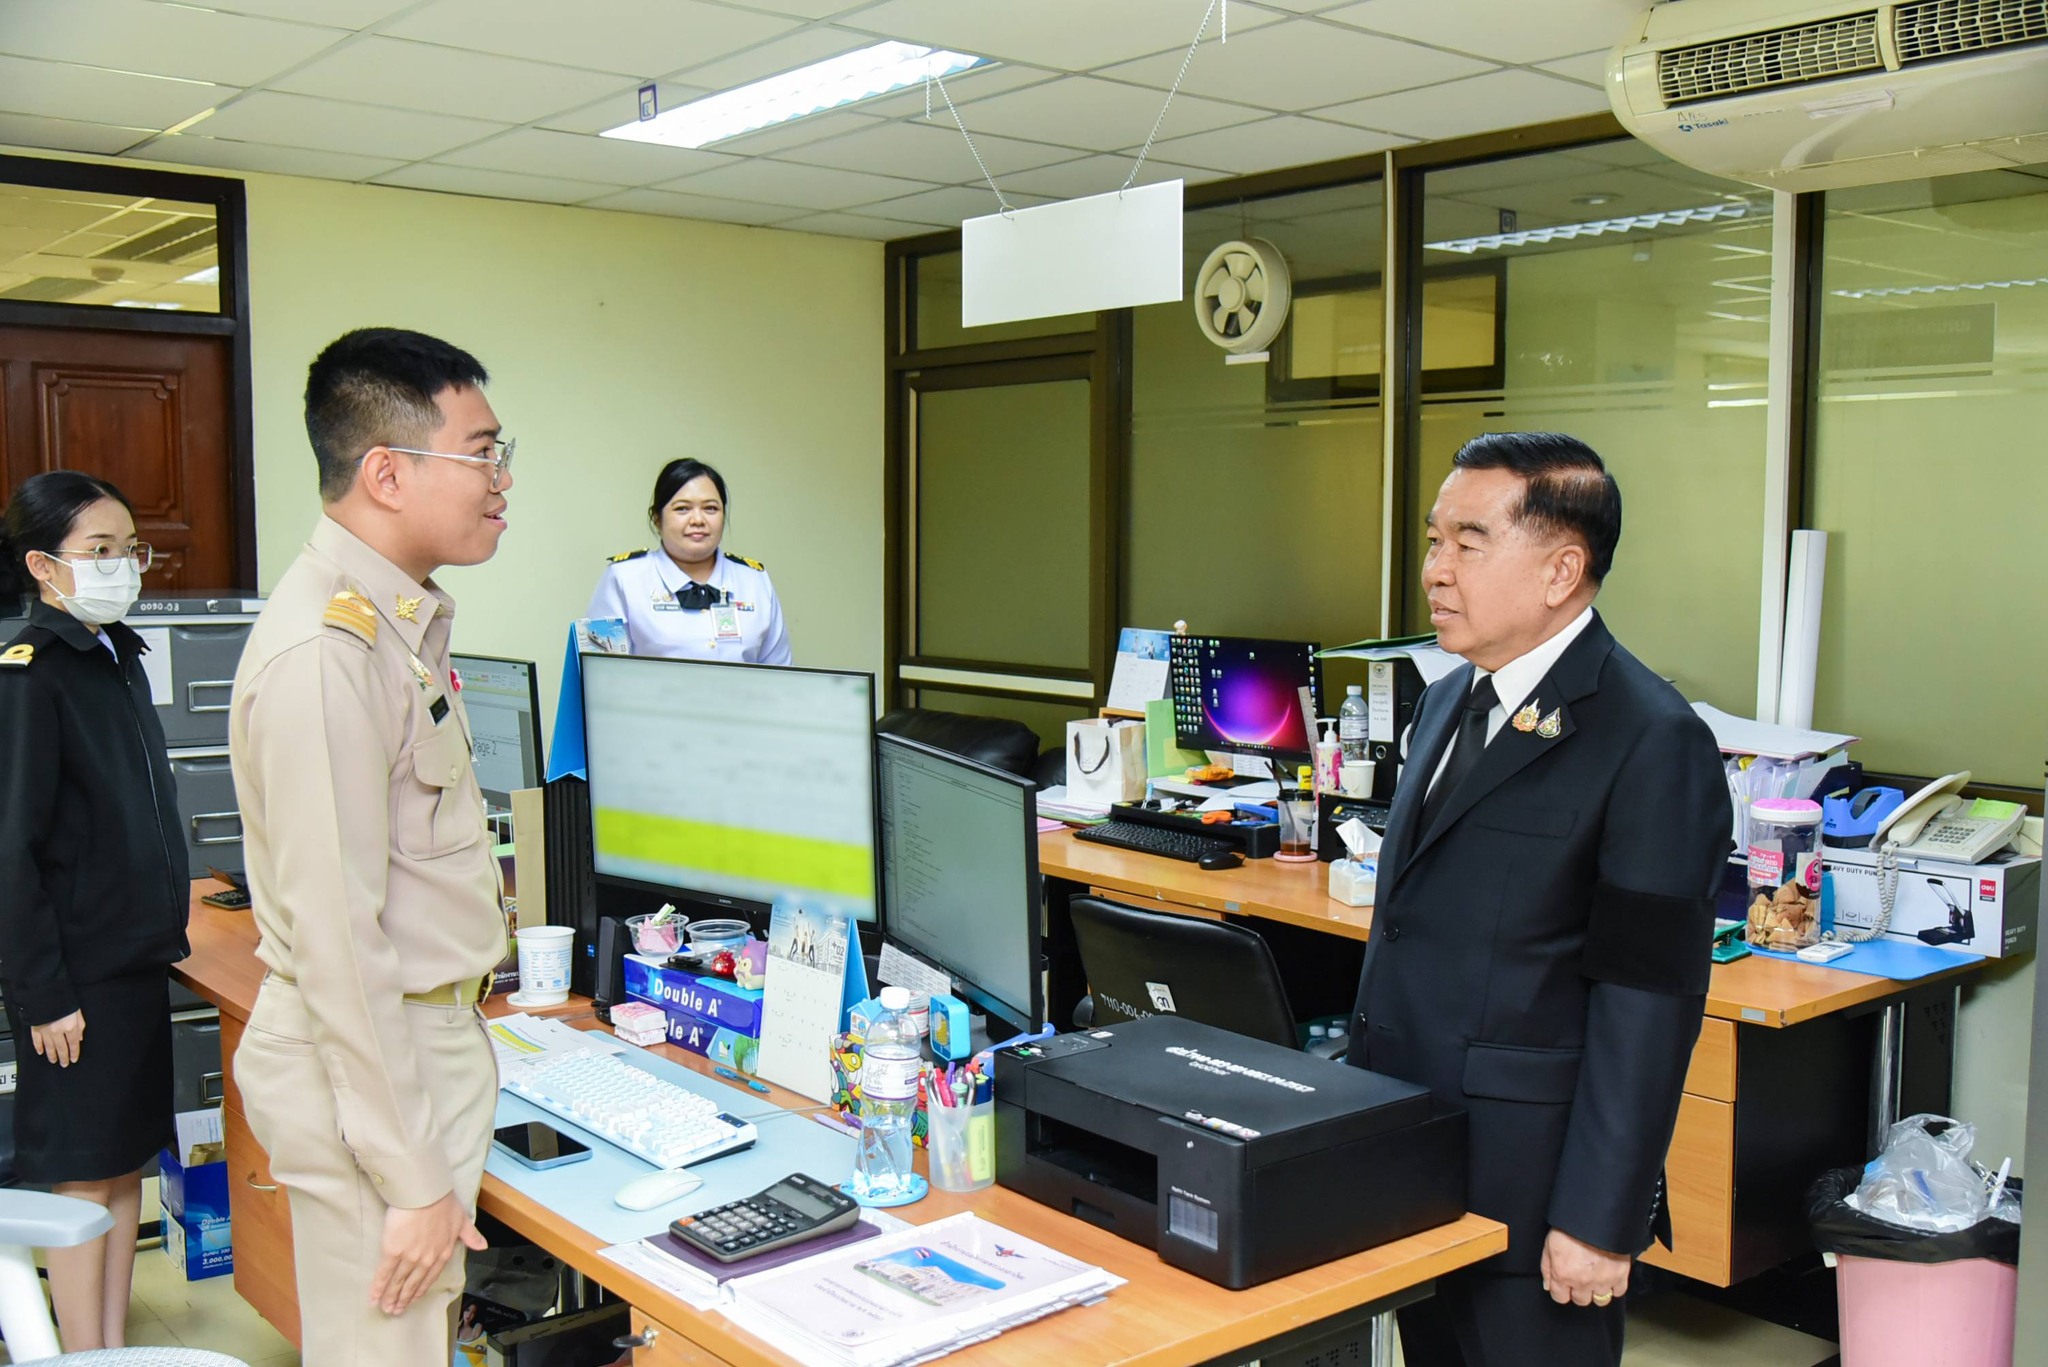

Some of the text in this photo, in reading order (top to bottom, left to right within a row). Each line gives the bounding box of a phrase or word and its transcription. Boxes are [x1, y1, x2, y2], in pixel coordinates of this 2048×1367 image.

[1696, 118, 1729, 129] Tasaki
[492, 740, 498, 755] 2
[1846, 867, 1863, 875] DUTY
[653, 976, 703, 1012] Double
